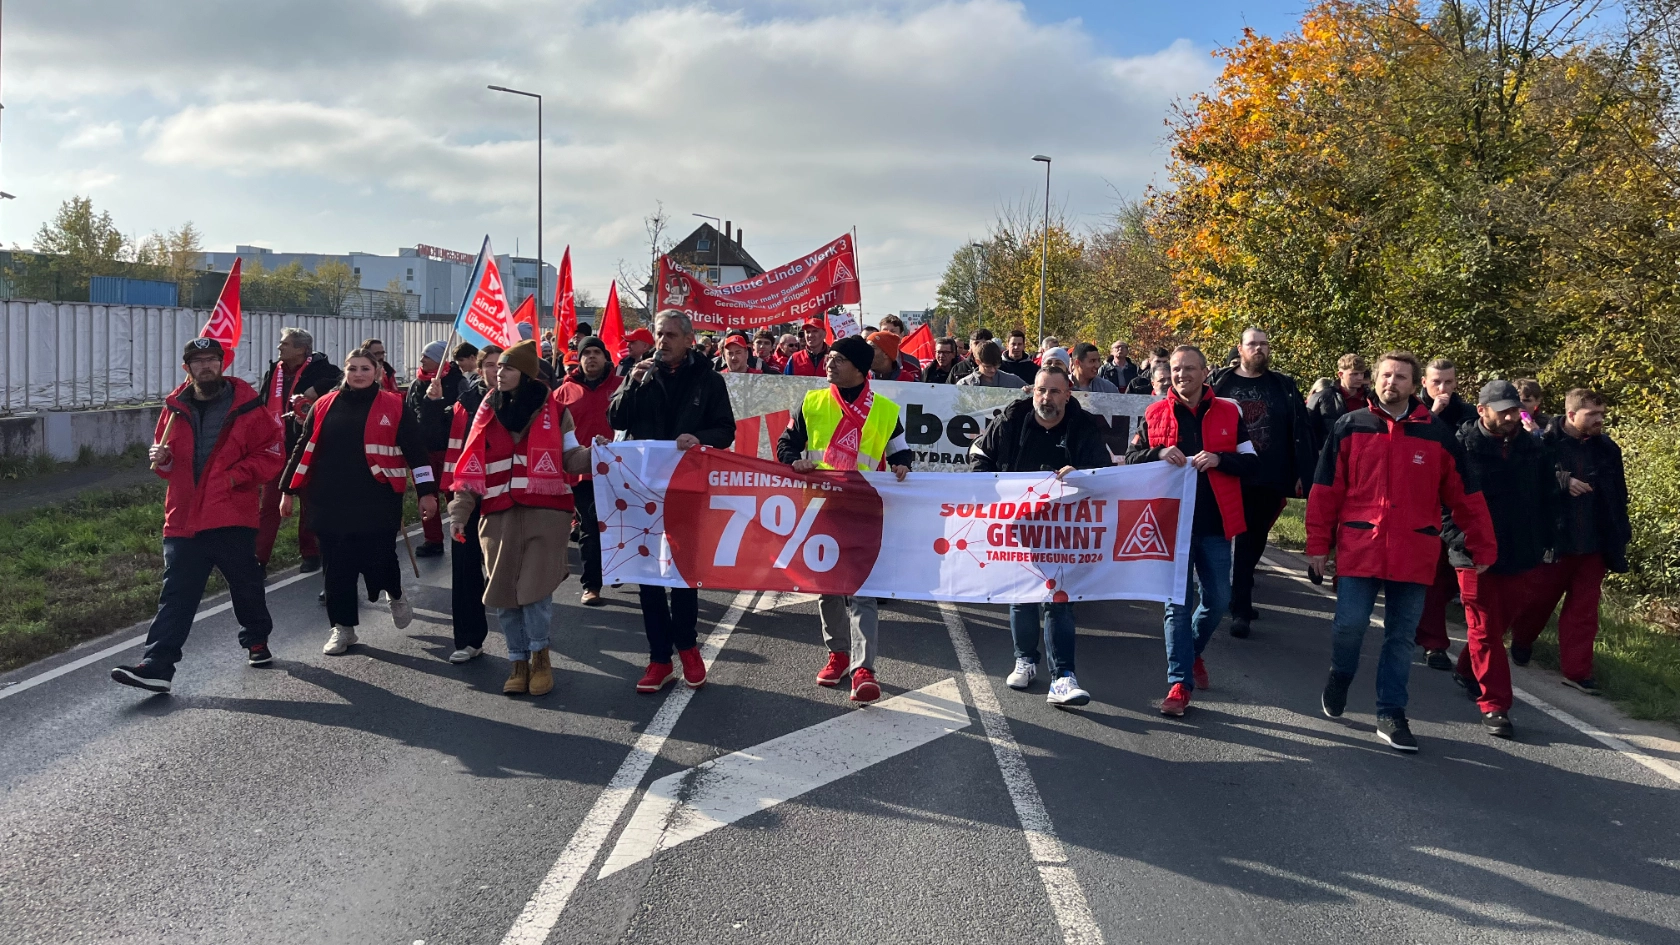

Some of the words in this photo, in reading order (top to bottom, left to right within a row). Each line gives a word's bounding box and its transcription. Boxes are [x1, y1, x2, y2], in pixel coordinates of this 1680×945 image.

[766, 266, 804, 284] Linde
[805, 246, 838, 268] Werk
[839, 239, 848, 251] 3
[760, 292, 780, 303] mehr
[781, 275, 819, 295] Solidarität,
[767, 300, 782, 310] und
[783, 288, 810, 304] Entgelt!
[474, 297, 497, 316] sind
[684, 309, 724, 325] Streik
[728, 314, 745, 325] ist
[750, 310, 786, 325] unser
[791, 290, 837, 316] RECHT!
[708, 470, 807, 489] GEMEINSAM
[939, 497, 1107, 523] SOLIDARITÄT
[709, 494, 840, 573] 7%
[986, 523, 1107, 550] GEWINNT
[986, 550, 1076, 564] TARIFBEWEGUNG
[1078, 553, 1103, 565] 2024
